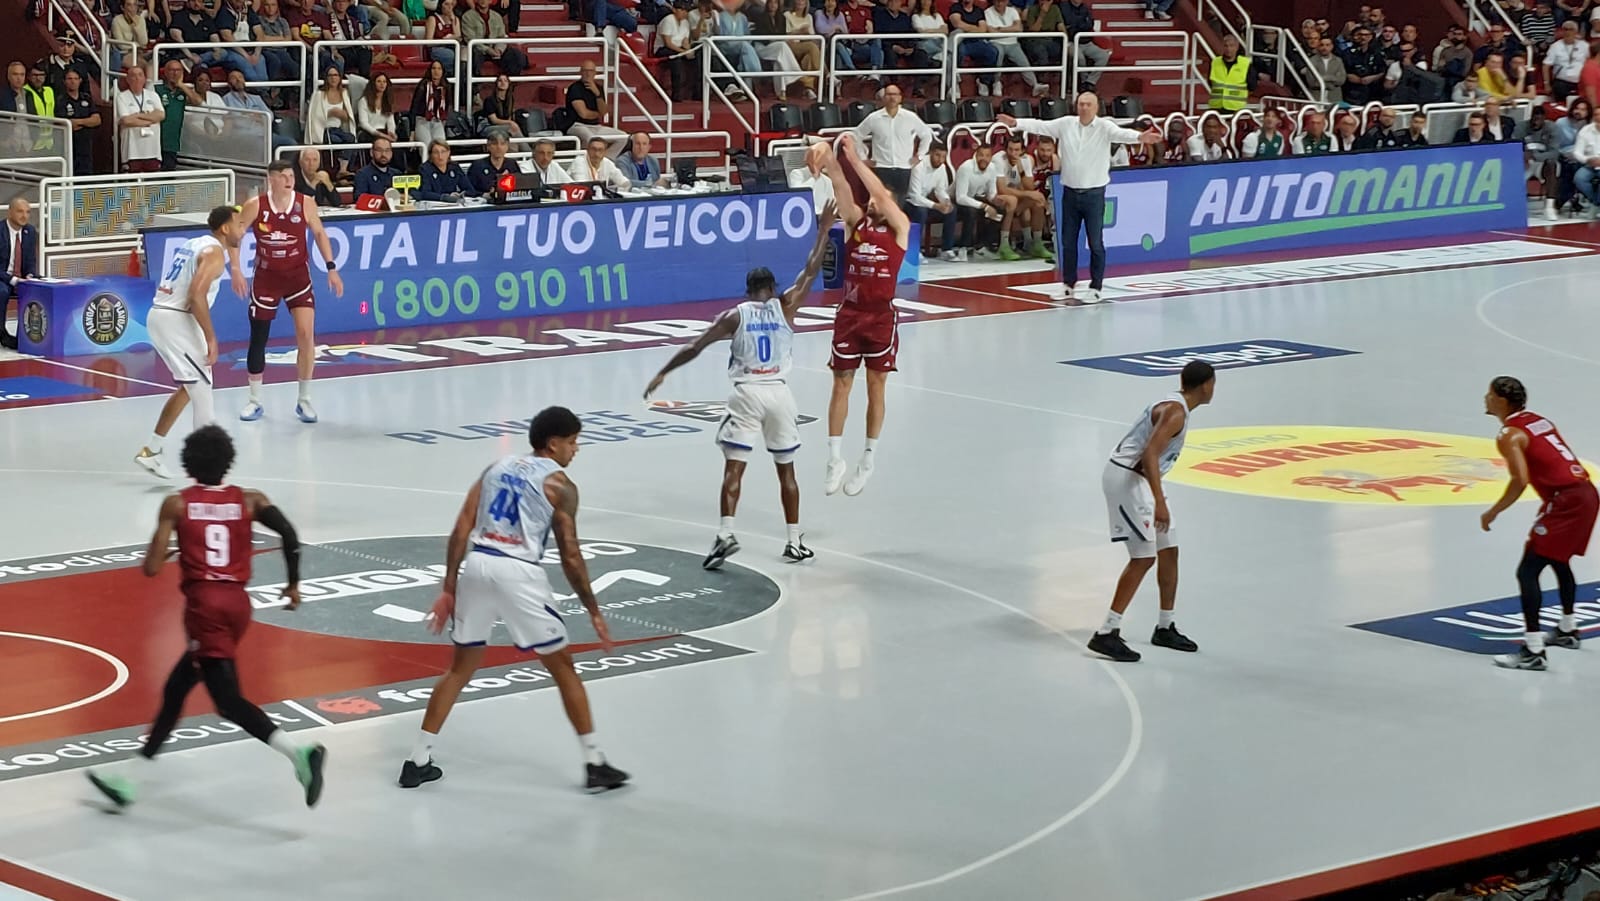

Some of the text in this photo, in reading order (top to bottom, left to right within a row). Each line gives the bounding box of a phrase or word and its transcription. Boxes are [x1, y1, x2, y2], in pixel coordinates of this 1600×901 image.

[1190, 157, 1502, 227] AUTOMANIA
[436, 218, 479, 265] IL
[497, 209, 597, 260] TUO
[613, 196, 812, 252] VEICOLO
[395, 262, 629, 320] 800 910 111
[757, 335, 772, 363] 0
[1119, 343, 1300, 367] Unipol
[384, 409, 639, 445] PLAYFF
[1188, 438, 1453, 478] AURIGA
[1544, 433, 1575, 462] 5
[488, 488, 523, 527] 44
[204, 523, 231, 568] 9
